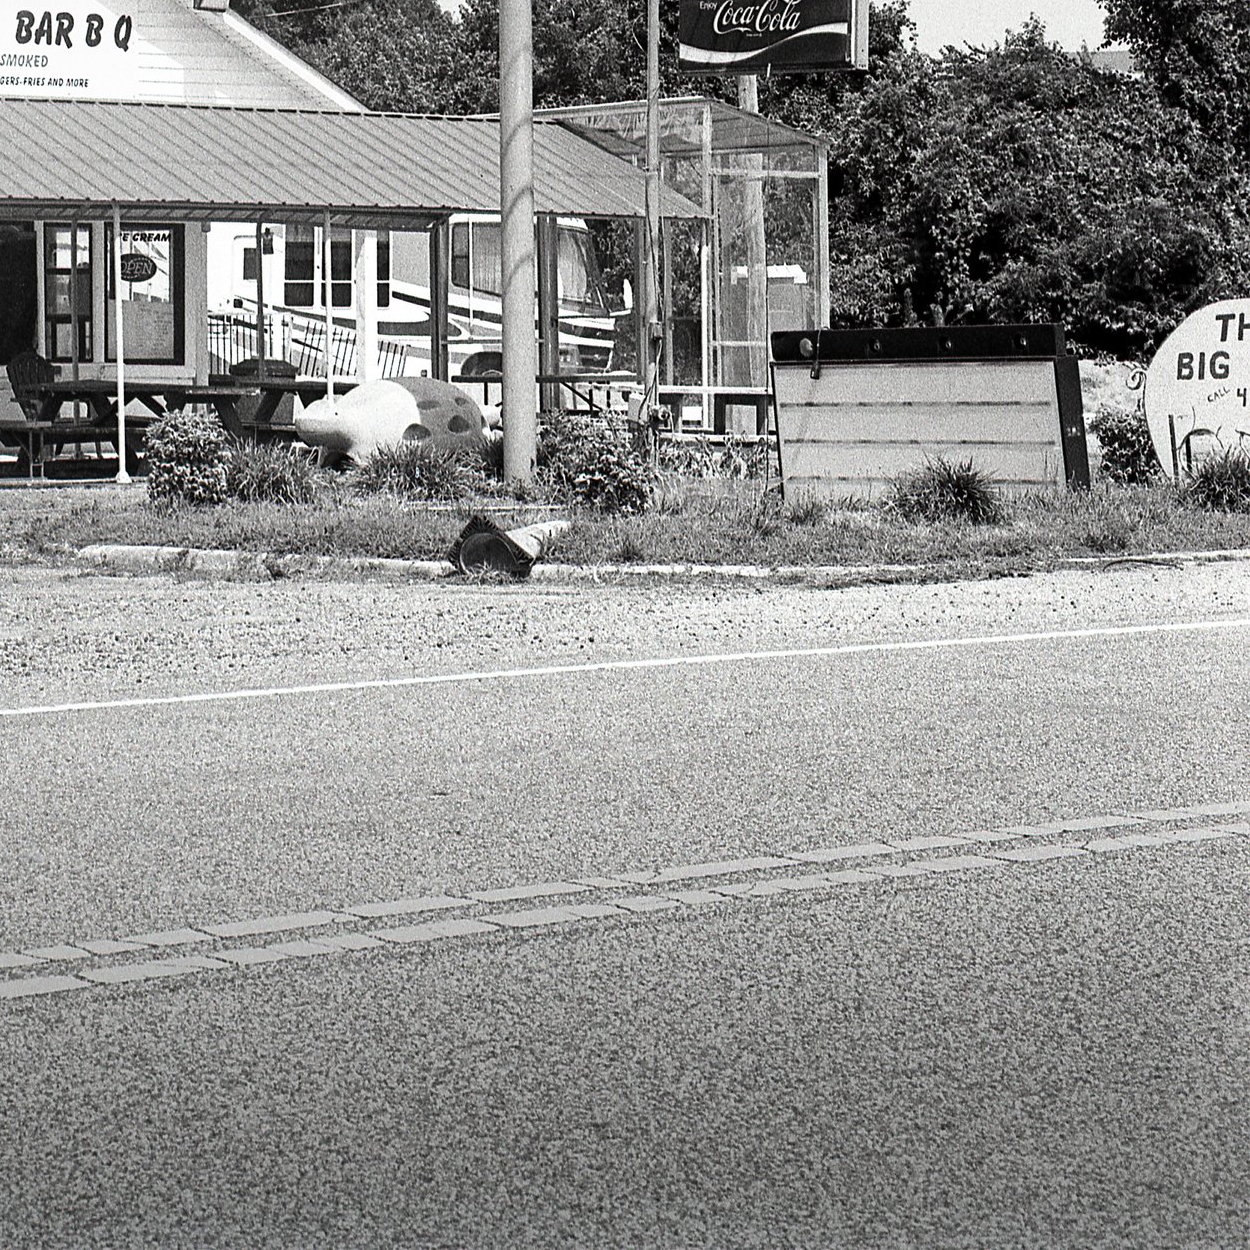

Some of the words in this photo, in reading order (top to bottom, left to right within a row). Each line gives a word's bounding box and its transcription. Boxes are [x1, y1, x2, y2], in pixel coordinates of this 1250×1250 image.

[699, 0, 718, 11] Enjoy
[15, 9, 75, 49] BAR
[85, 13, 104, 47] B
[114, 14, 133, 52] Q
[0, 53, 49, 68] SMOKED
[47, 77, 64, 87] AND
[65, 78, 90, 88] MORE
[132, 232, 171, 242] CREAM
[1176, 350, 1230, 380] BIG
[1207, 386, 1231, 403] CALL
